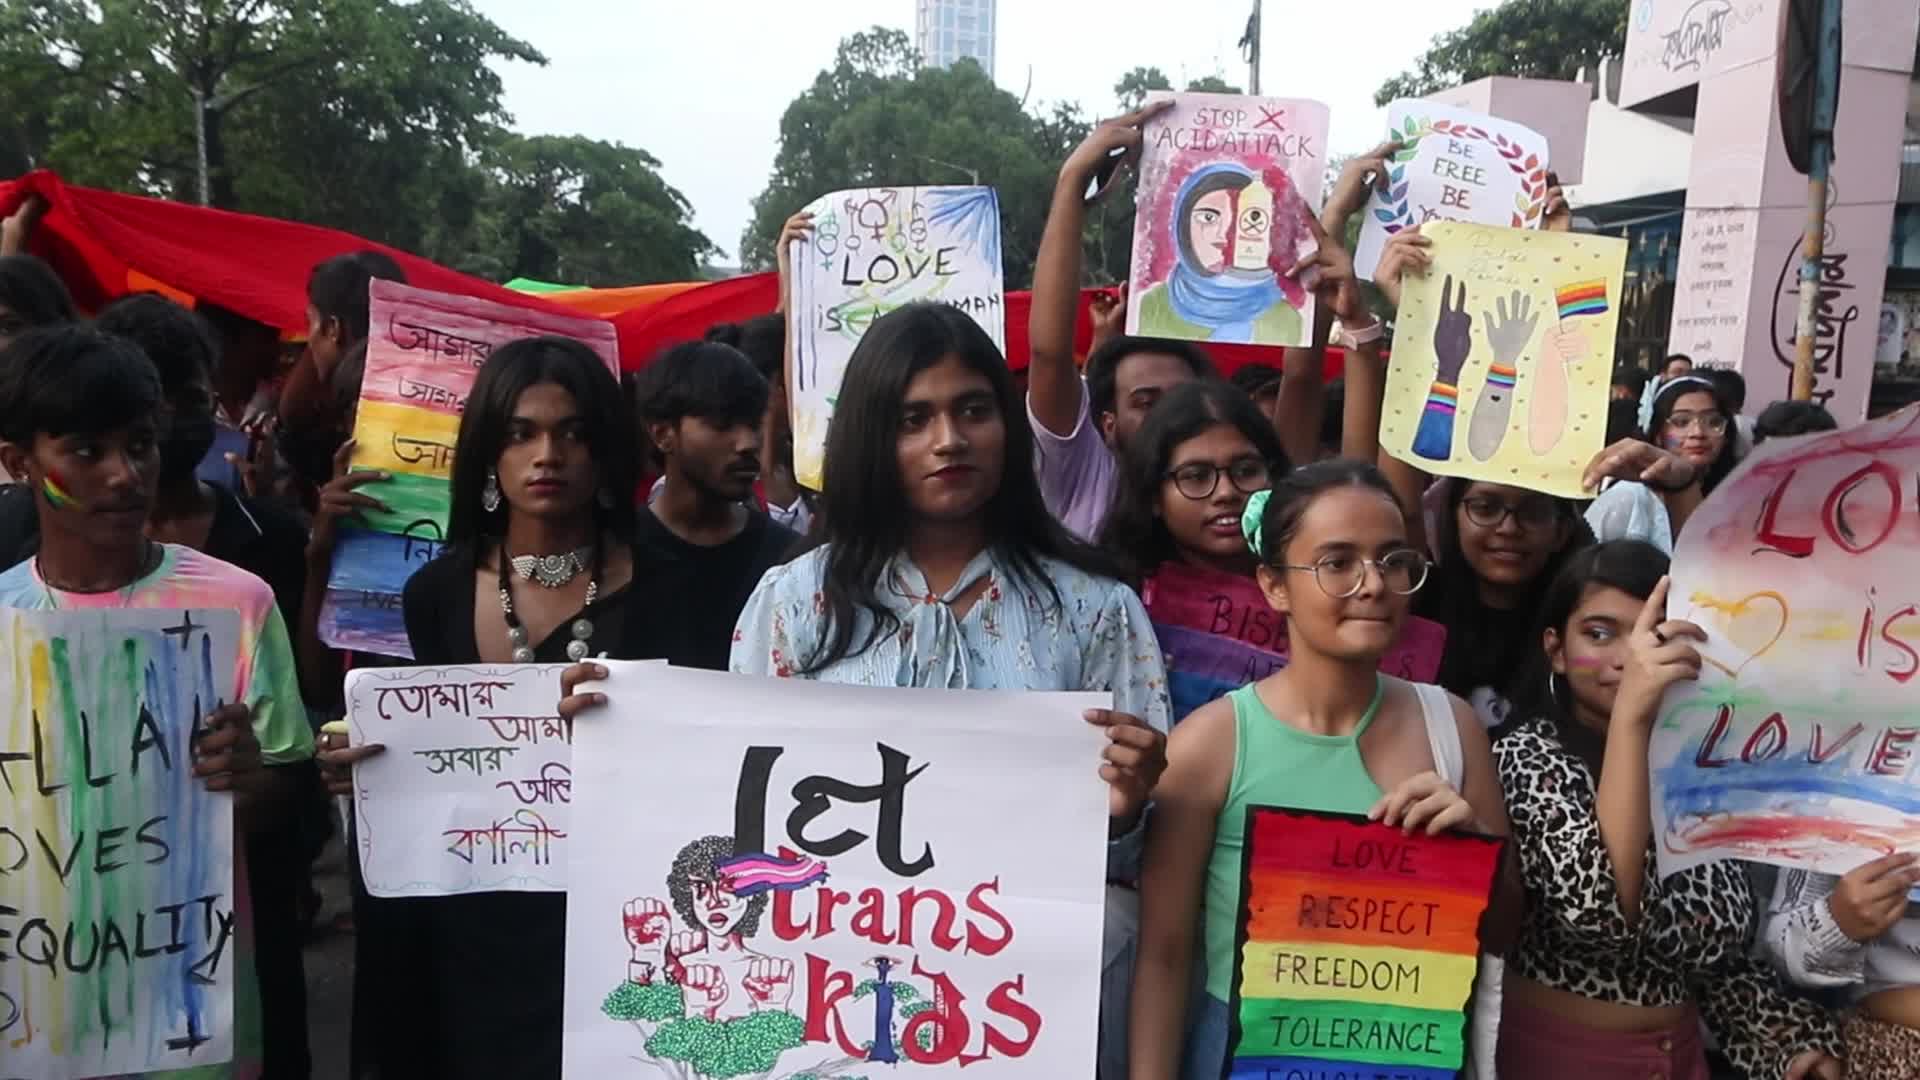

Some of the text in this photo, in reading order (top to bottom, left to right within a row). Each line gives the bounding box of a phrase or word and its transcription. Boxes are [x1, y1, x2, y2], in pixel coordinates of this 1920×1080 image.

[1193, 107, 1248, 127] STOP
[1448, 139, 1476, 159] BE
[1432, 157, 1487, 186] FREE
[1440, 185, 1471, 210] BE
[841, 246, 961, 286] LOVE
[1752, 458, 1920, 558] LO
[374, 682, 515, 719] তোমার
[478, 716, 573, 745] আমা
[1695, 702, 1920, 775] LOVE
[1332, 836, 1418, 874] LOVE
[769, 845, 1014, 957] trans
[1297, 894, 1440, 937] RESPECT
[1275, 952, 1420, 994] FREEDOM
[803, 951, 1043, 1068] kids
[1270, 1014, 1441, 1055] TOLERANCE
